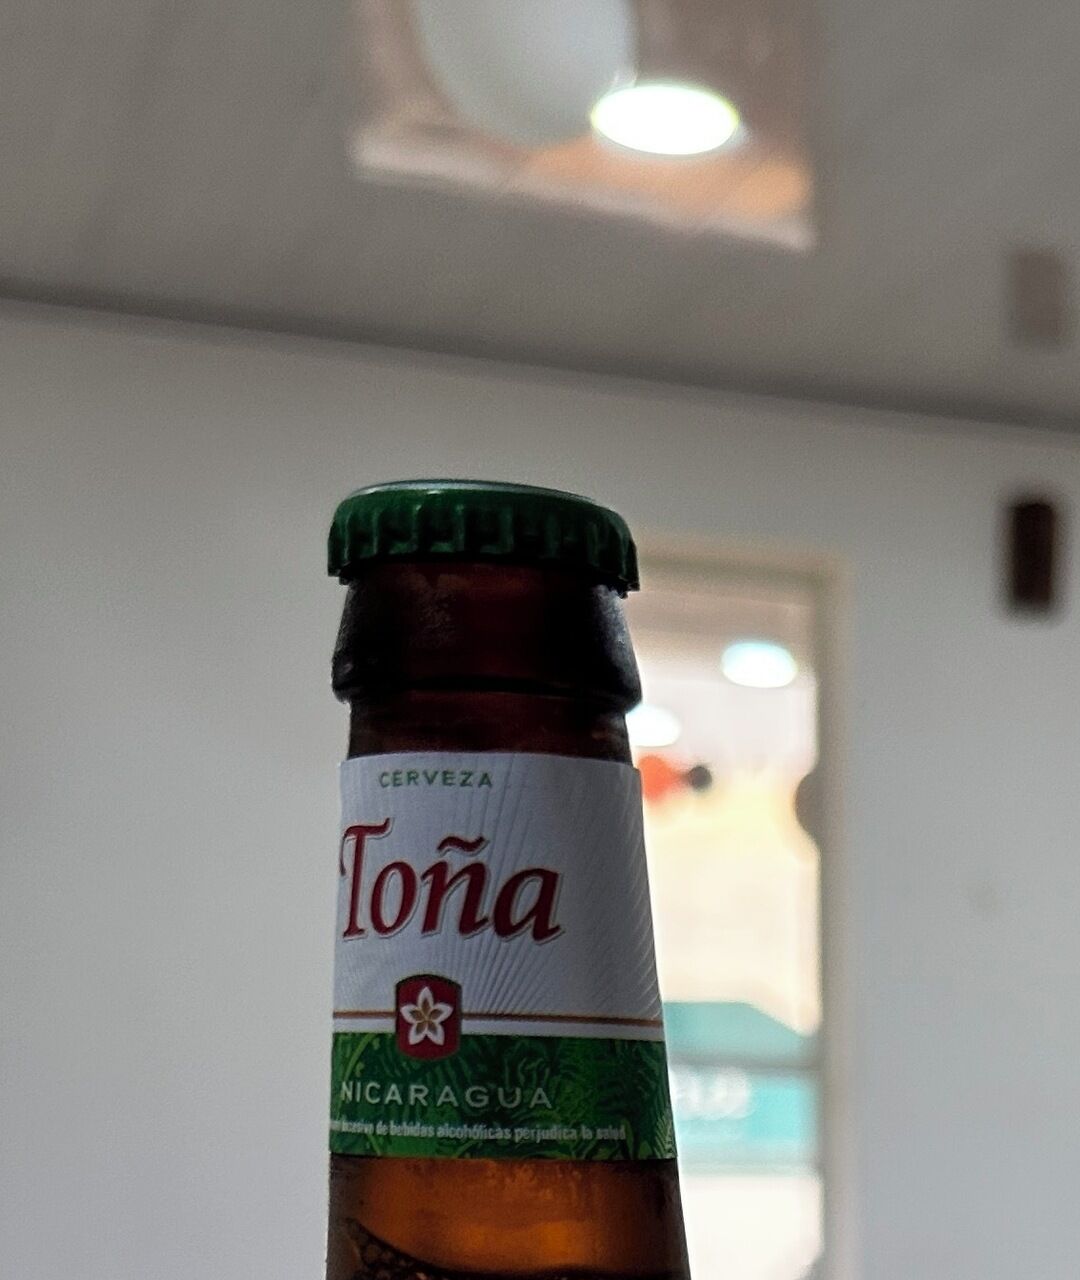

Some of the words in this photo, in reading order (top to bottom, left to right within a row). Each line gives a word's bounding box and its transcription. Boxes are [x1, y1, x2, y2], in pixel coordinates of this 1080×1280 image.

[379, 769, 493, 788] CERVEZA
[339, 817, 563, 942] Toña
[341, 1080, 552, 1110] NICARAGUA
